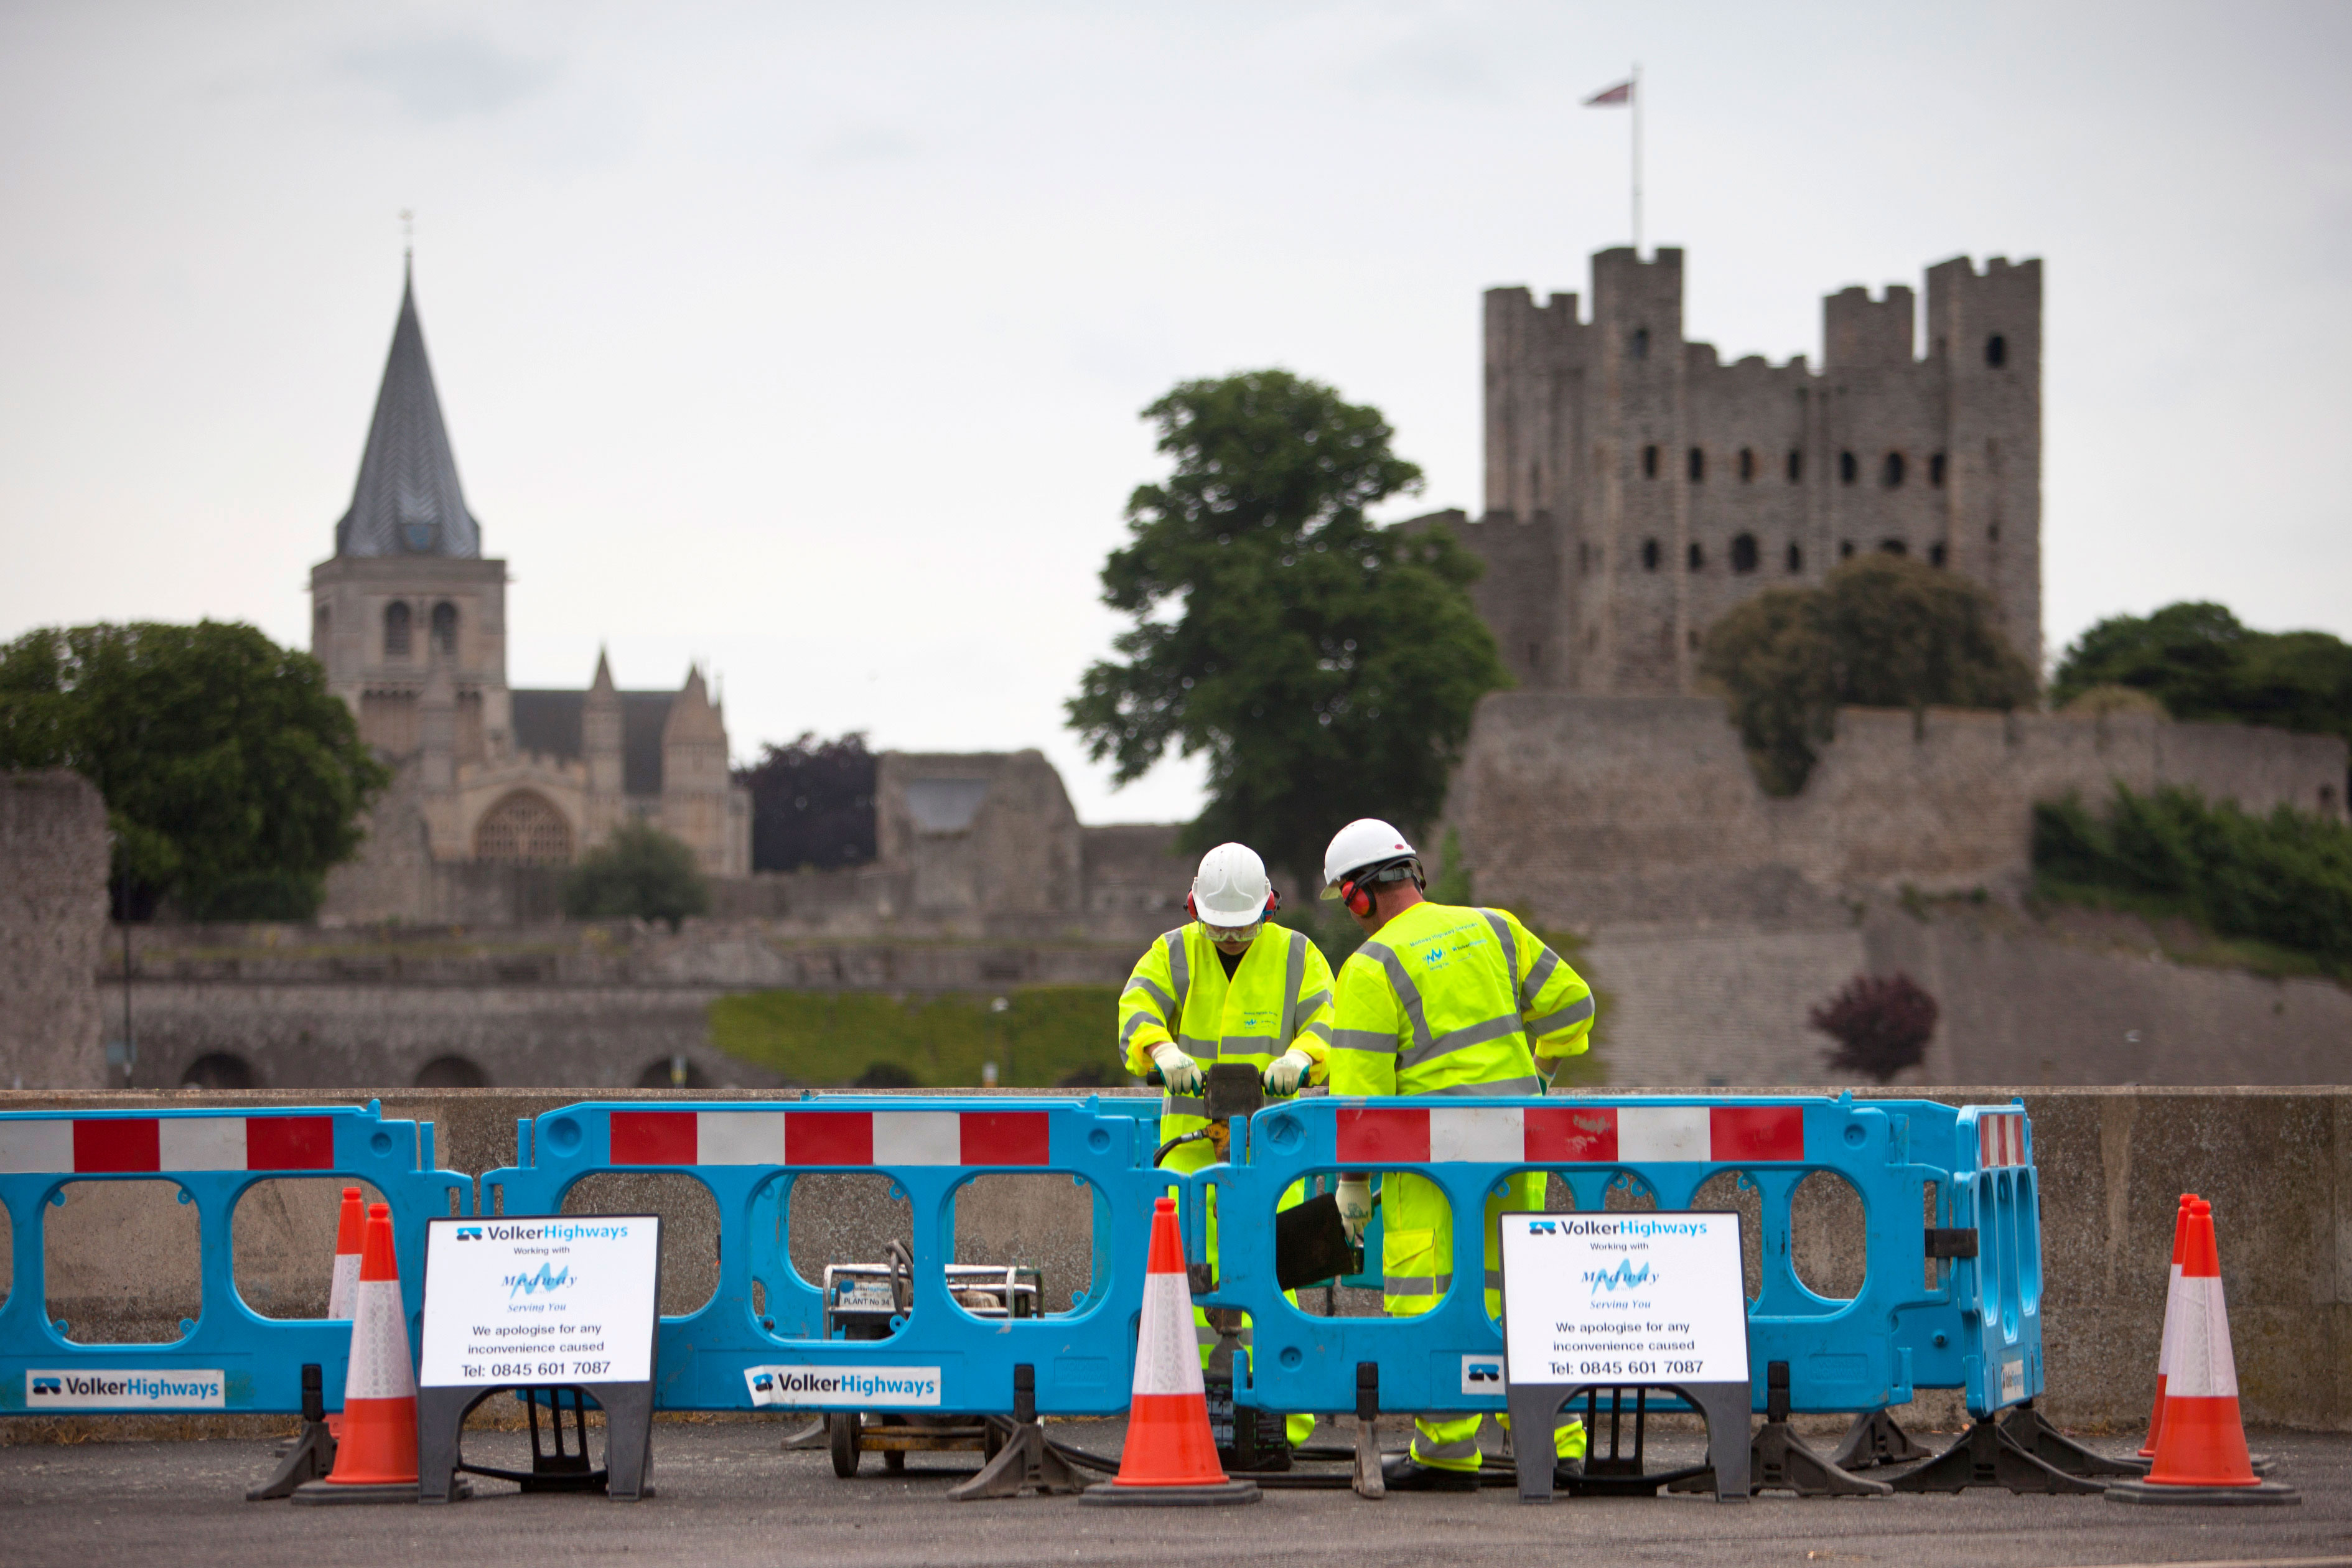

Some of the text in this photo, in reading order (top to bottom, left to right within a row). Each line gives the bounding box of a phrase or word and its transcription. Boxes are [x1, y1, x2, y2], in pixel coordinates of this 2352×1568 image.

[488, 1225, 627, 1242] VolkerHighways
[1561, 1220, 1707, 1238] VolkerHighways
[513, 1247, 549, 1256] Working
[1590, 1243, 1626, 1251] Working
[501, 1274, 577, 1288] Medway
[1582, 1270, 1659, 1286] Medway
[507, 1303, 566, 1312] Serving You
[1590, 1300, 1628, 1310] Serving
[473, 1324, 601, 1337] We apologise for any
[1556, 1322, 1689, 1335] We apologise for any
[469, 1342, 604, 1354] inconvenience caused
[1554, 1340, 1694, 1351] inconvenience caused
[462, 1361, 610, 1377] Tel: 0845 601 7087
[1549, 1361, 1703, 1374] Tel: 0845 601 7087
[66, 1378, 218, 1399] VolkerHighways
[778, 1373, 934, 1398] VolkerHighways
